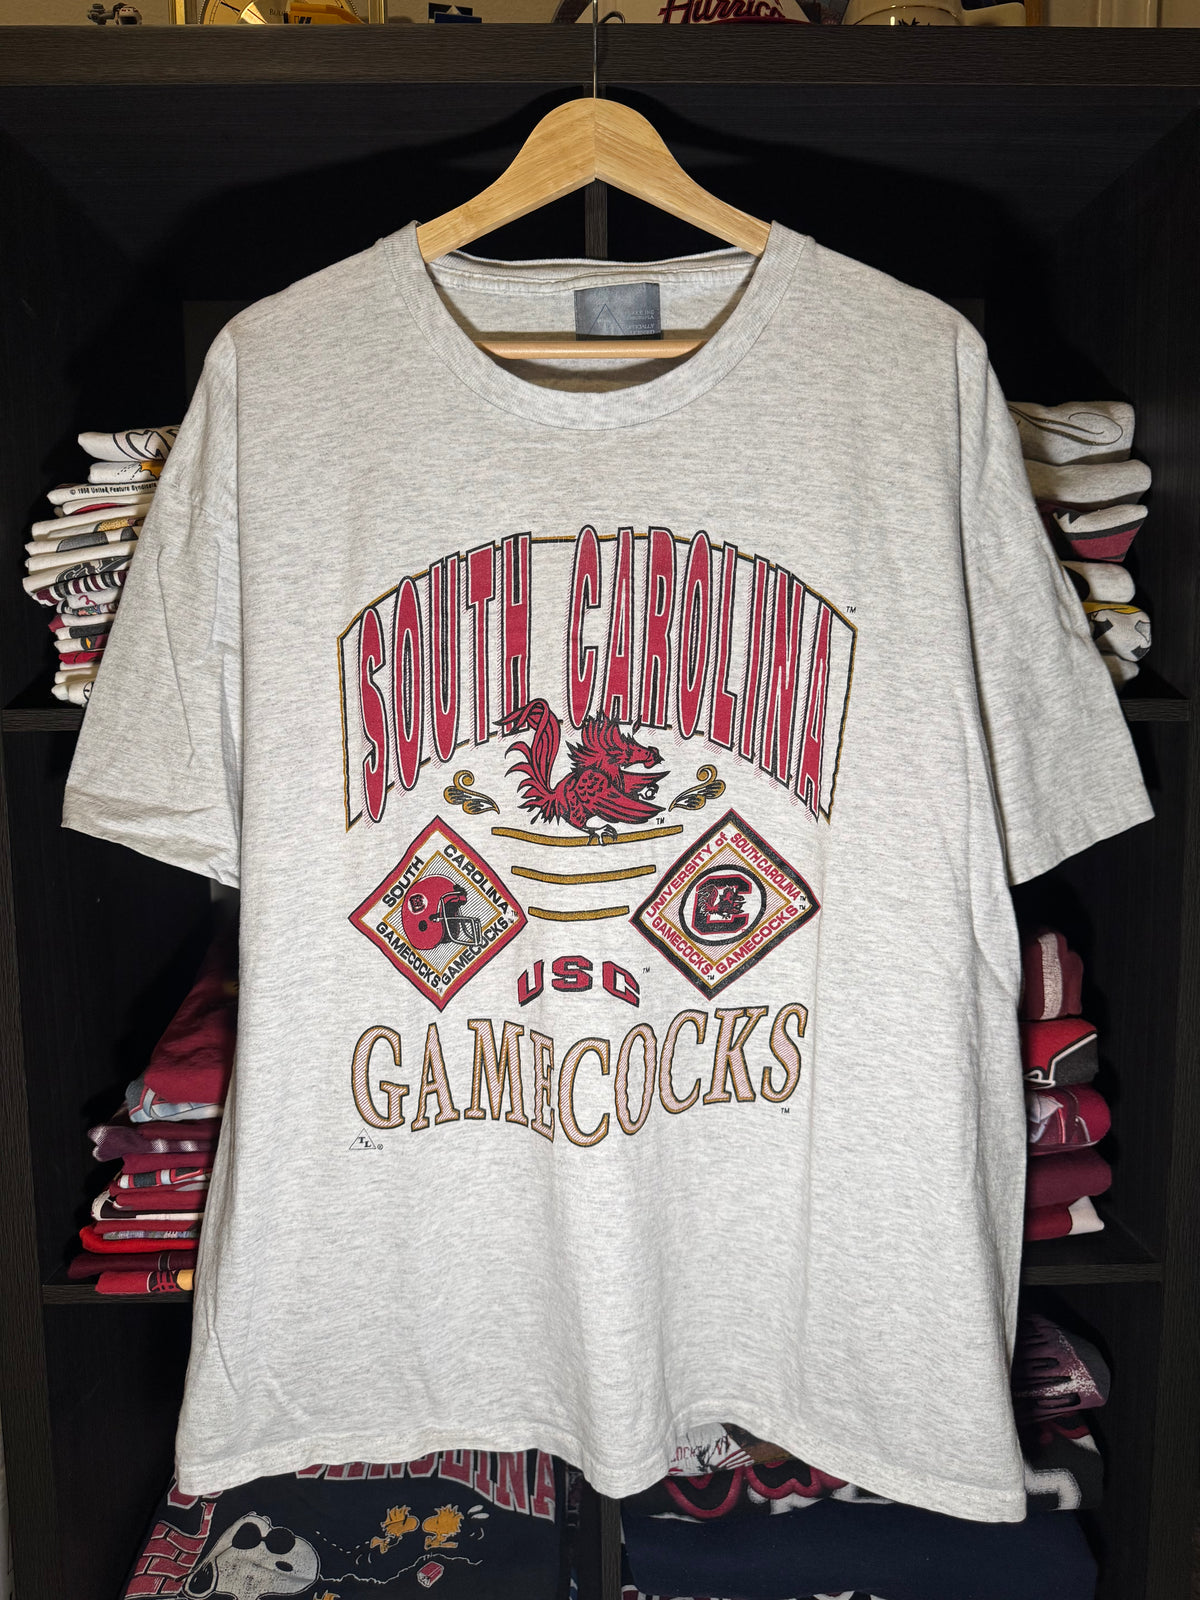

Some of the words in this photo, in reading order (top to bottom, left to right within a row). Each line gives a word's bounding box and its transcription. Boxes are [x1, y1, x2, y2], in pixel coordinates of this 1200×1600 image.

[109, 485, 130, 493] Feature
[358, 531, 532, 823] SOUTH
[567, 524, 834, 823] CAROLINA
[382, 856, 425, 908] SOUTH
[444, 844, 508, 915] CAROLINA
[646, 844, 711, 918] UNIVERSITY
[715, 831, 729, 846] of
[376, 921, 441, 988] GAMECOCKS
[441, 916, 510, 986] GAMECOCKS
[652, 914, 715, 976] GAMECOCKS
[715, 904, 799, 975] GAMECOCKS
[517, 955, 640, 1008] USC
[350, 1002, 809, 1147] GAMECOCKS
